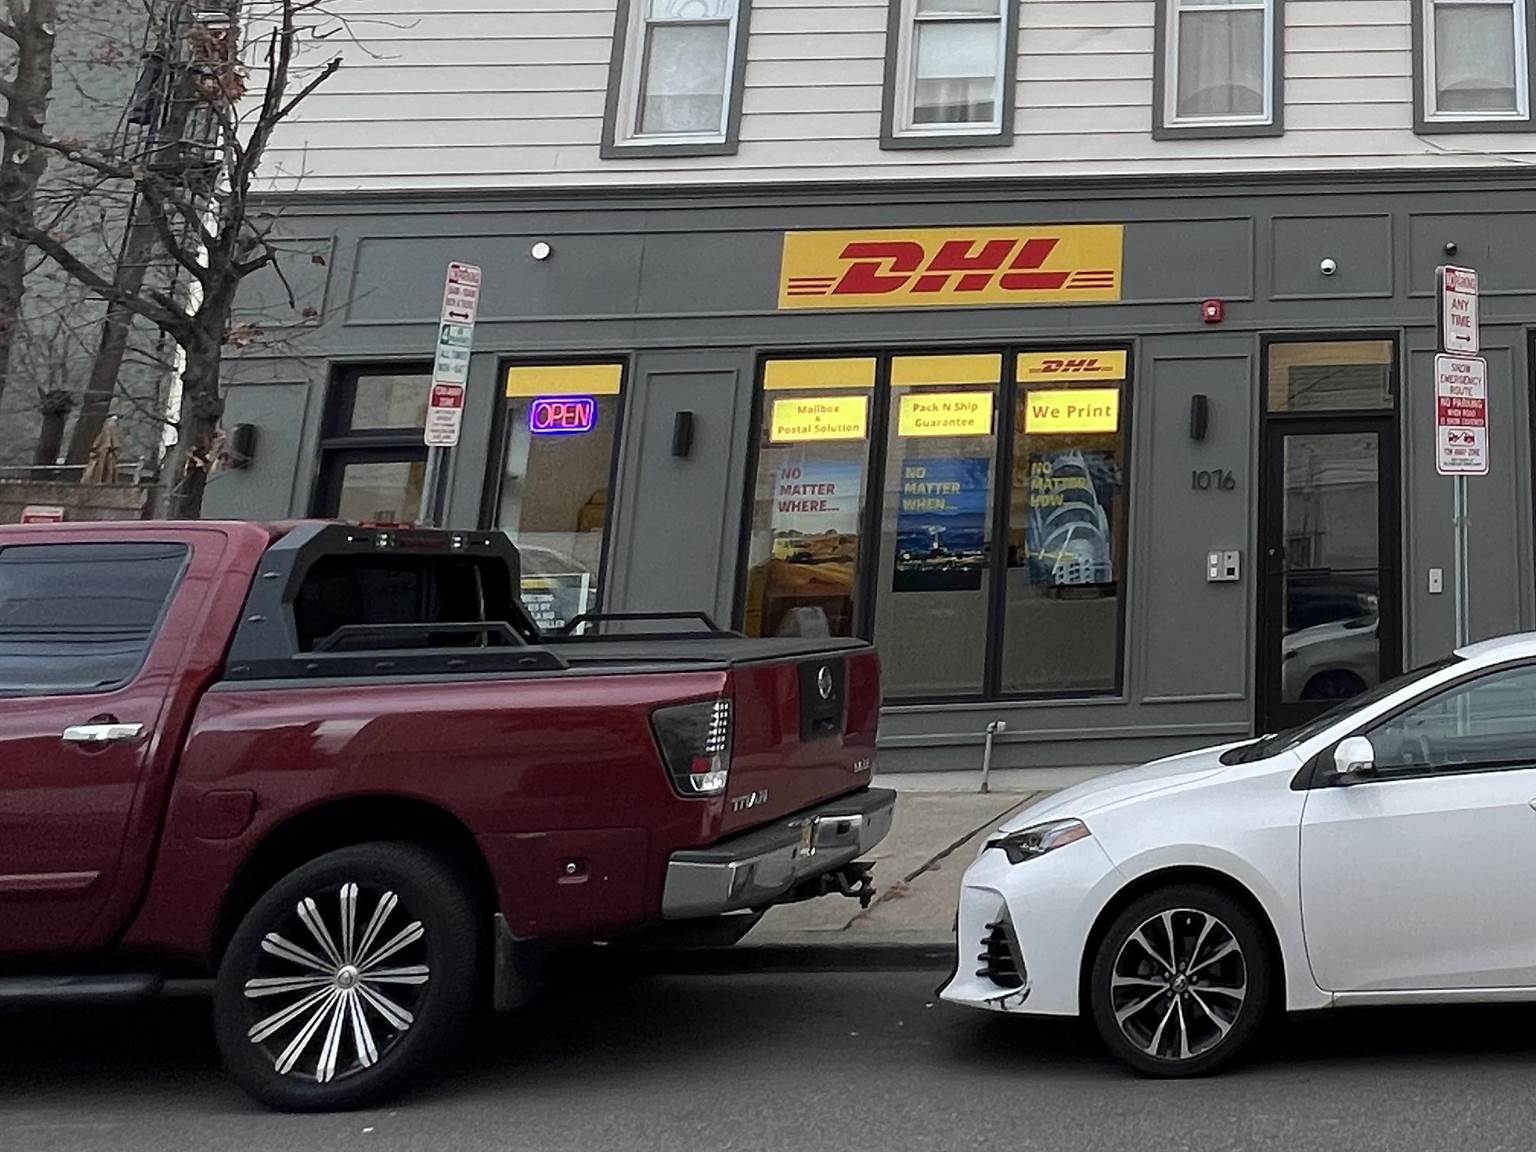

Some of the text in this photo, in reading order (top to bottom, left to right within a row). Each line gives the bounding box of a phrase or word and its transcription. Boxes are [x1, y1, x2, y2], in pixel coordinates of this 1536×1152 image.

[831, 238, 1072, 295] DHL
[1451, 298, 1469, 312] ANY
[1451, 314, 1471, 327] TIME
[1041, 358, 1101, 373] DHL
[797, 404, 839, 414] Mailbox
[913, 401, 978, 413] Pack N Ship
[1032, 404, 1112, 418] We Print
[535, 403, 590, 428] OPEN
[778, 423, 859, 434] Postal Solution
[914, 418, 974, 427] Guarantee
[781, 467, 801, 480] NO
[905, 467, 926, 479] NO
[1031, 461, 1052, 474] NO
[1191, 469, 1236, 490] 1076
[779, 483, 835, 496] MATTER
[904, 482, 960, 495] MATTER
